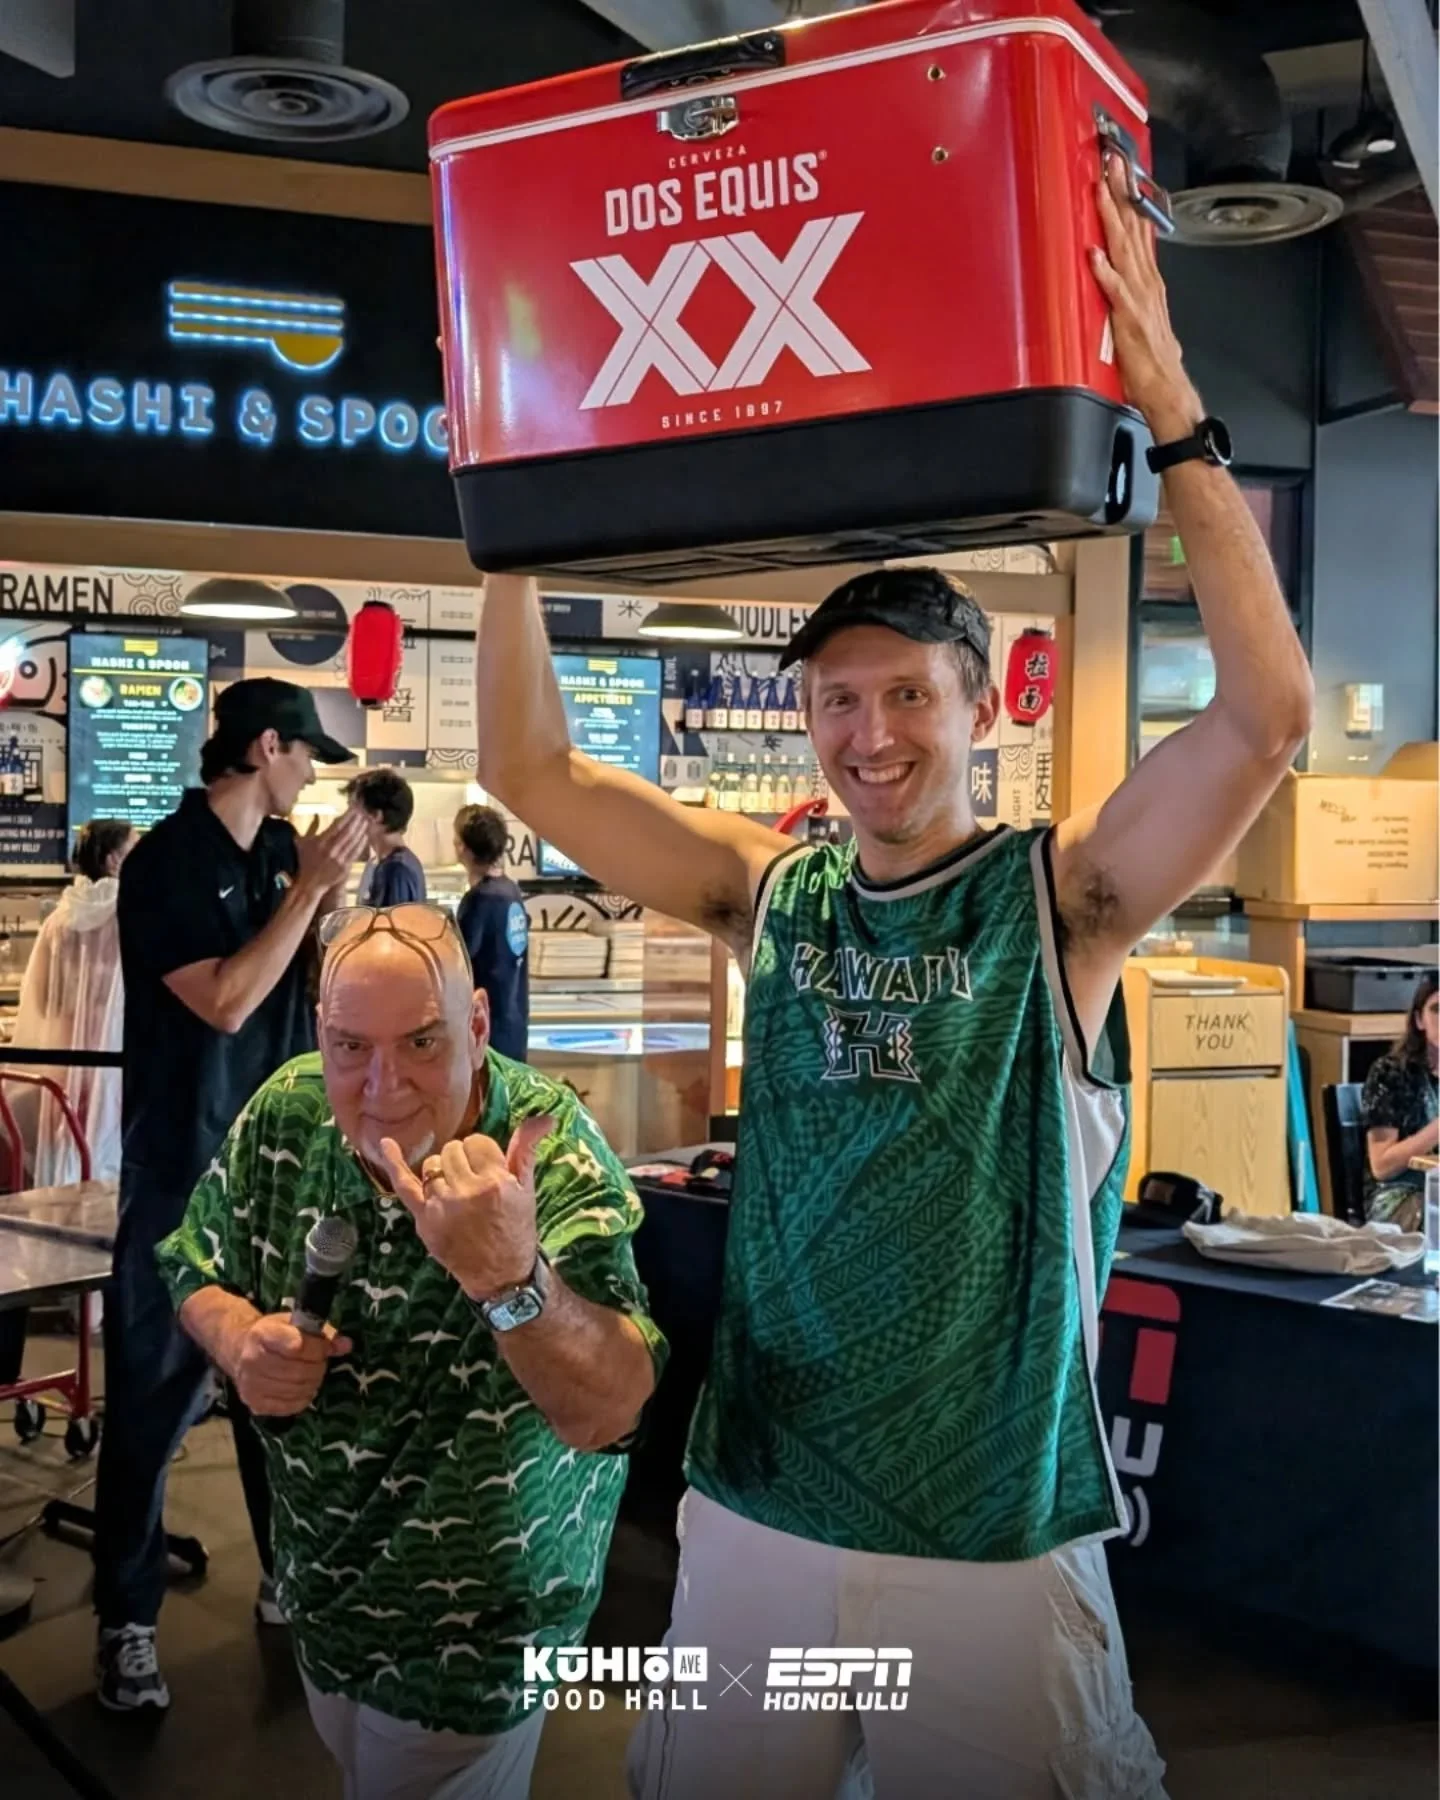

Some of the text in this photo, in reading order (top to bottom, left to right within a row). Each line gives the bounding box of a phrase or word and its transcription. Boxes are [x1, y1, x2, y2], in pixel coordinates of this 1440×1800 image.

[669, 145, 747, 168] CERVEZA
[605, 152, 819, 236] DOS EQUIS
[569, 211, 873, 410] XX
[0, 370, 215, 432] HASHI
[238, 388, 276, 443] &
[661, 408, 722, 429] SINCE
[0, 573, 113, 614] RAMEN
[724, 605, 808, 638] OODLE
[120, 684, 162, 696] RAMEN
[971, 761, 993, 804] 味
[1184, 1009, 1250, 1031] THANK
[821, 1004, 921, 1082] H
[1195, 1033, 1234, 1051] YOU
